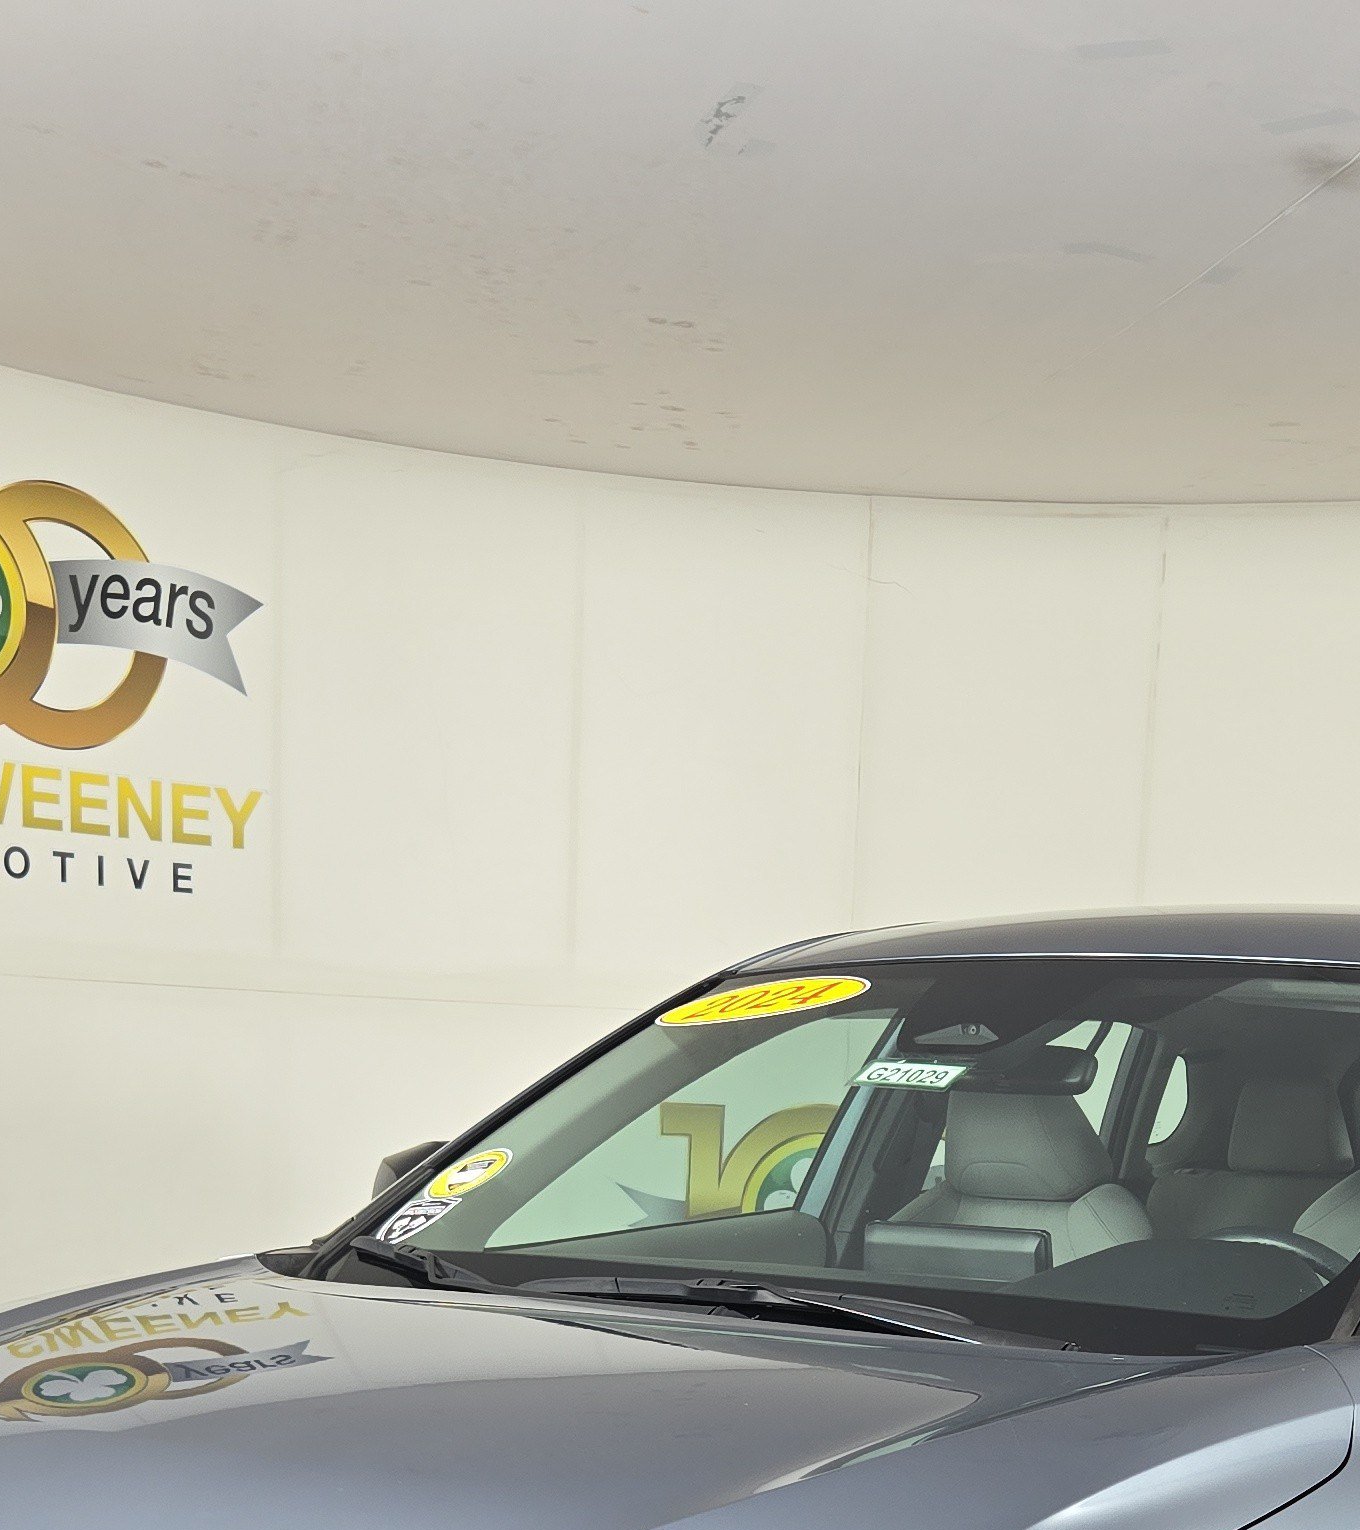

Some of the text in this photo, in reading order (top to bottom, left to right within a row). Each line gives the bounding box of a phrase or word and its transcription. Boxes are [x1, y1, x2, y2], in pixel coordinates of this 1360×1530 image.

[68, 571, 215, 640] years
[681, 980, 844, 1021] 2024
[866, 1065, 950, 1085] G21029
